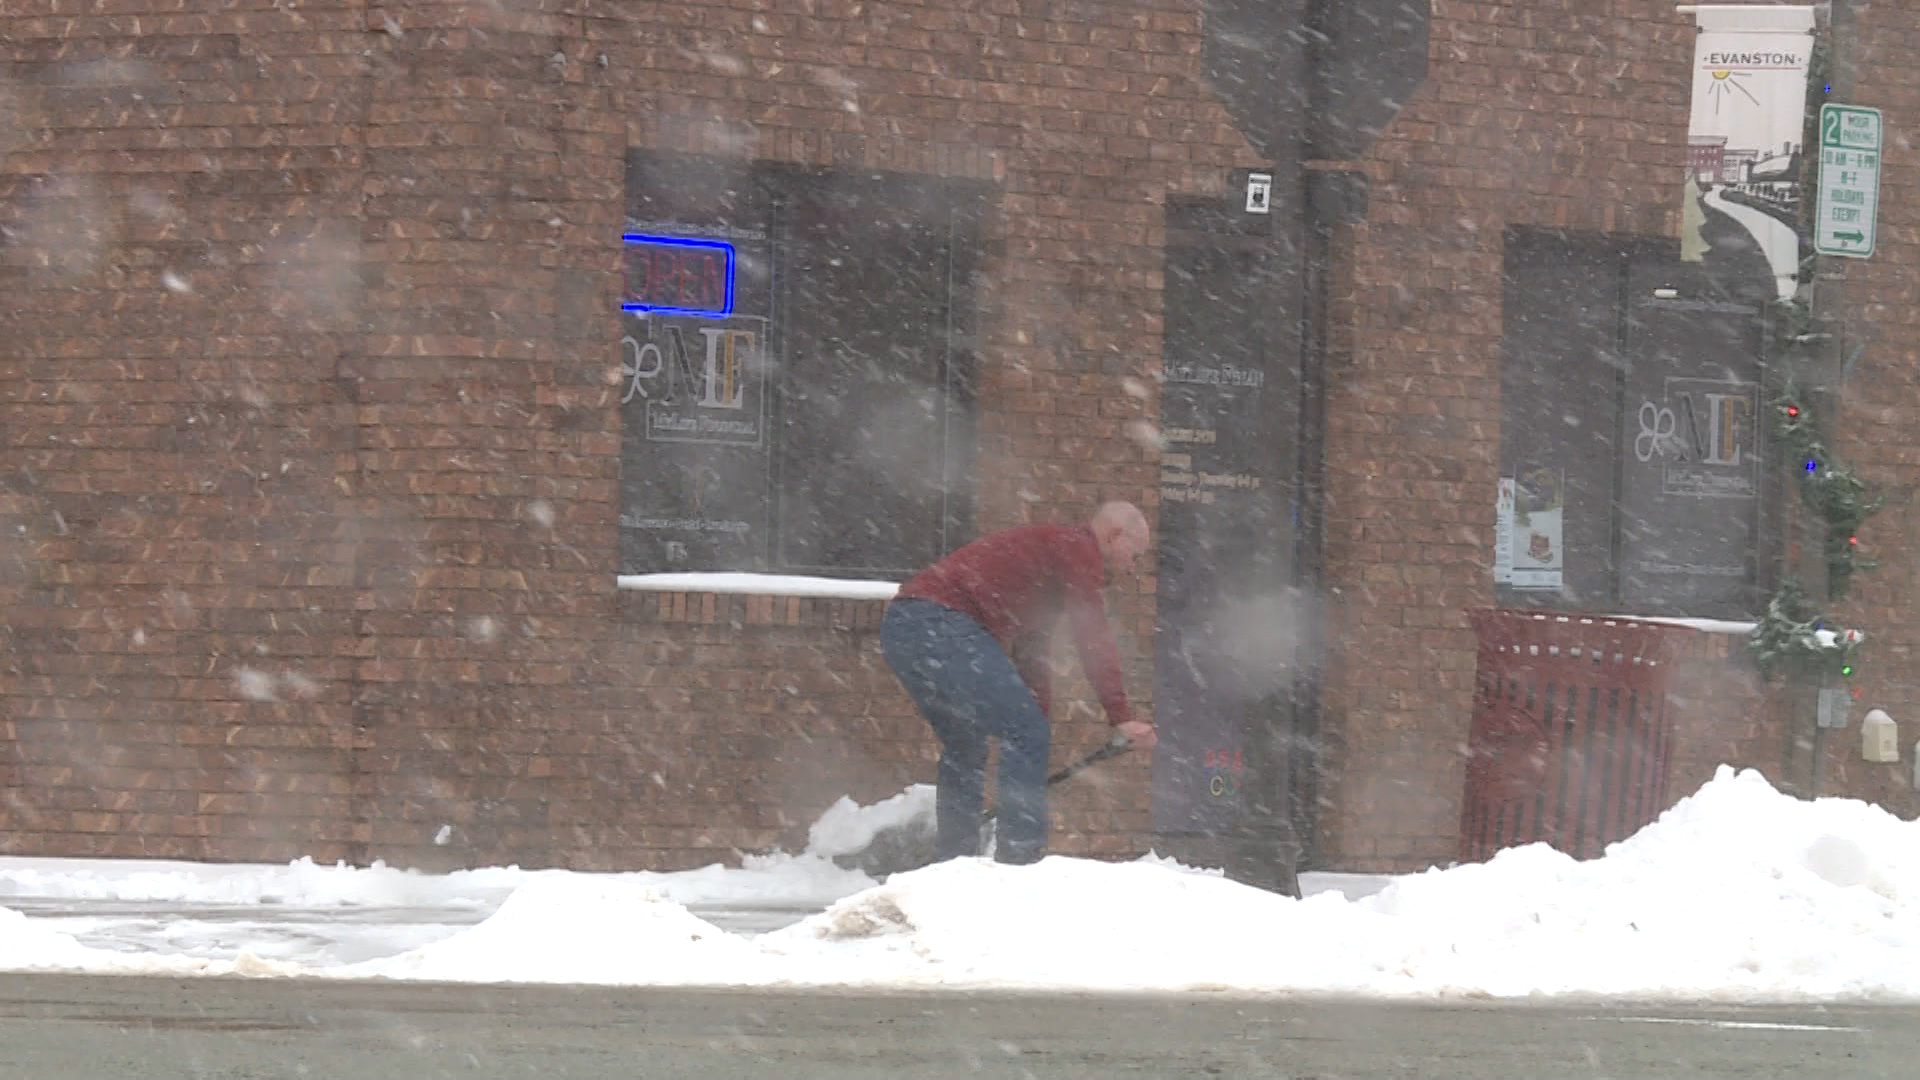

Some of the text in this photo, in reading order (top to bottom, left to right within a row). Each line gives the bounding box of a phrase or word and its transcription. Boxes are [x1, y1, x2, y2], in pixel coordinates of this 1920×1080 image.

[1709, 53, 1795, 65] EVANSTON
[1825, 110, 1838, 144] 2
[623, 250, 727, 305] OPEN
